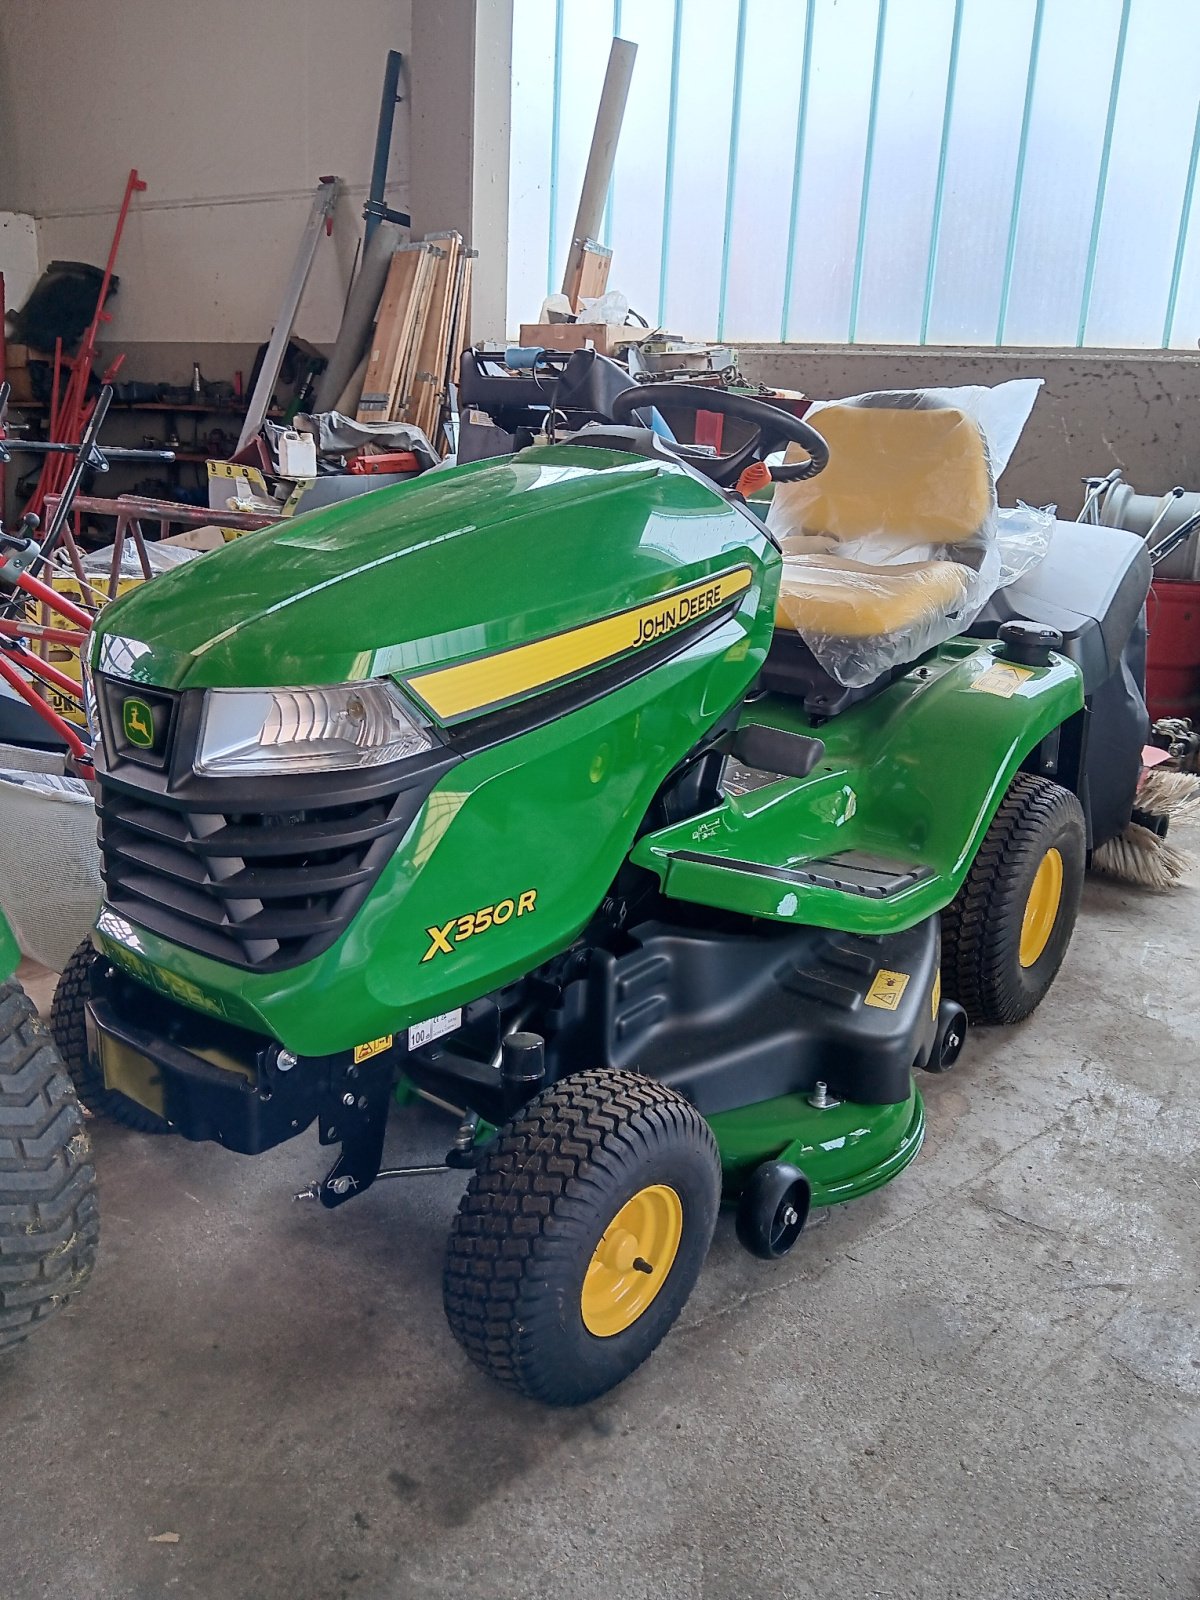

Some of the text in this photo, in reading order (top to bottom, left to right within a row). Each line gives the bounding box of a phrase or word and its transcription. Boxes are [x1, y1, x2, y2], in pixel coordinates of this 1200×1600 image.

[633, 585, 721, 645] JOHN DEERE
[420, 889, 537, 963] X350 R
[412, 1029, 424, 1045] 100
